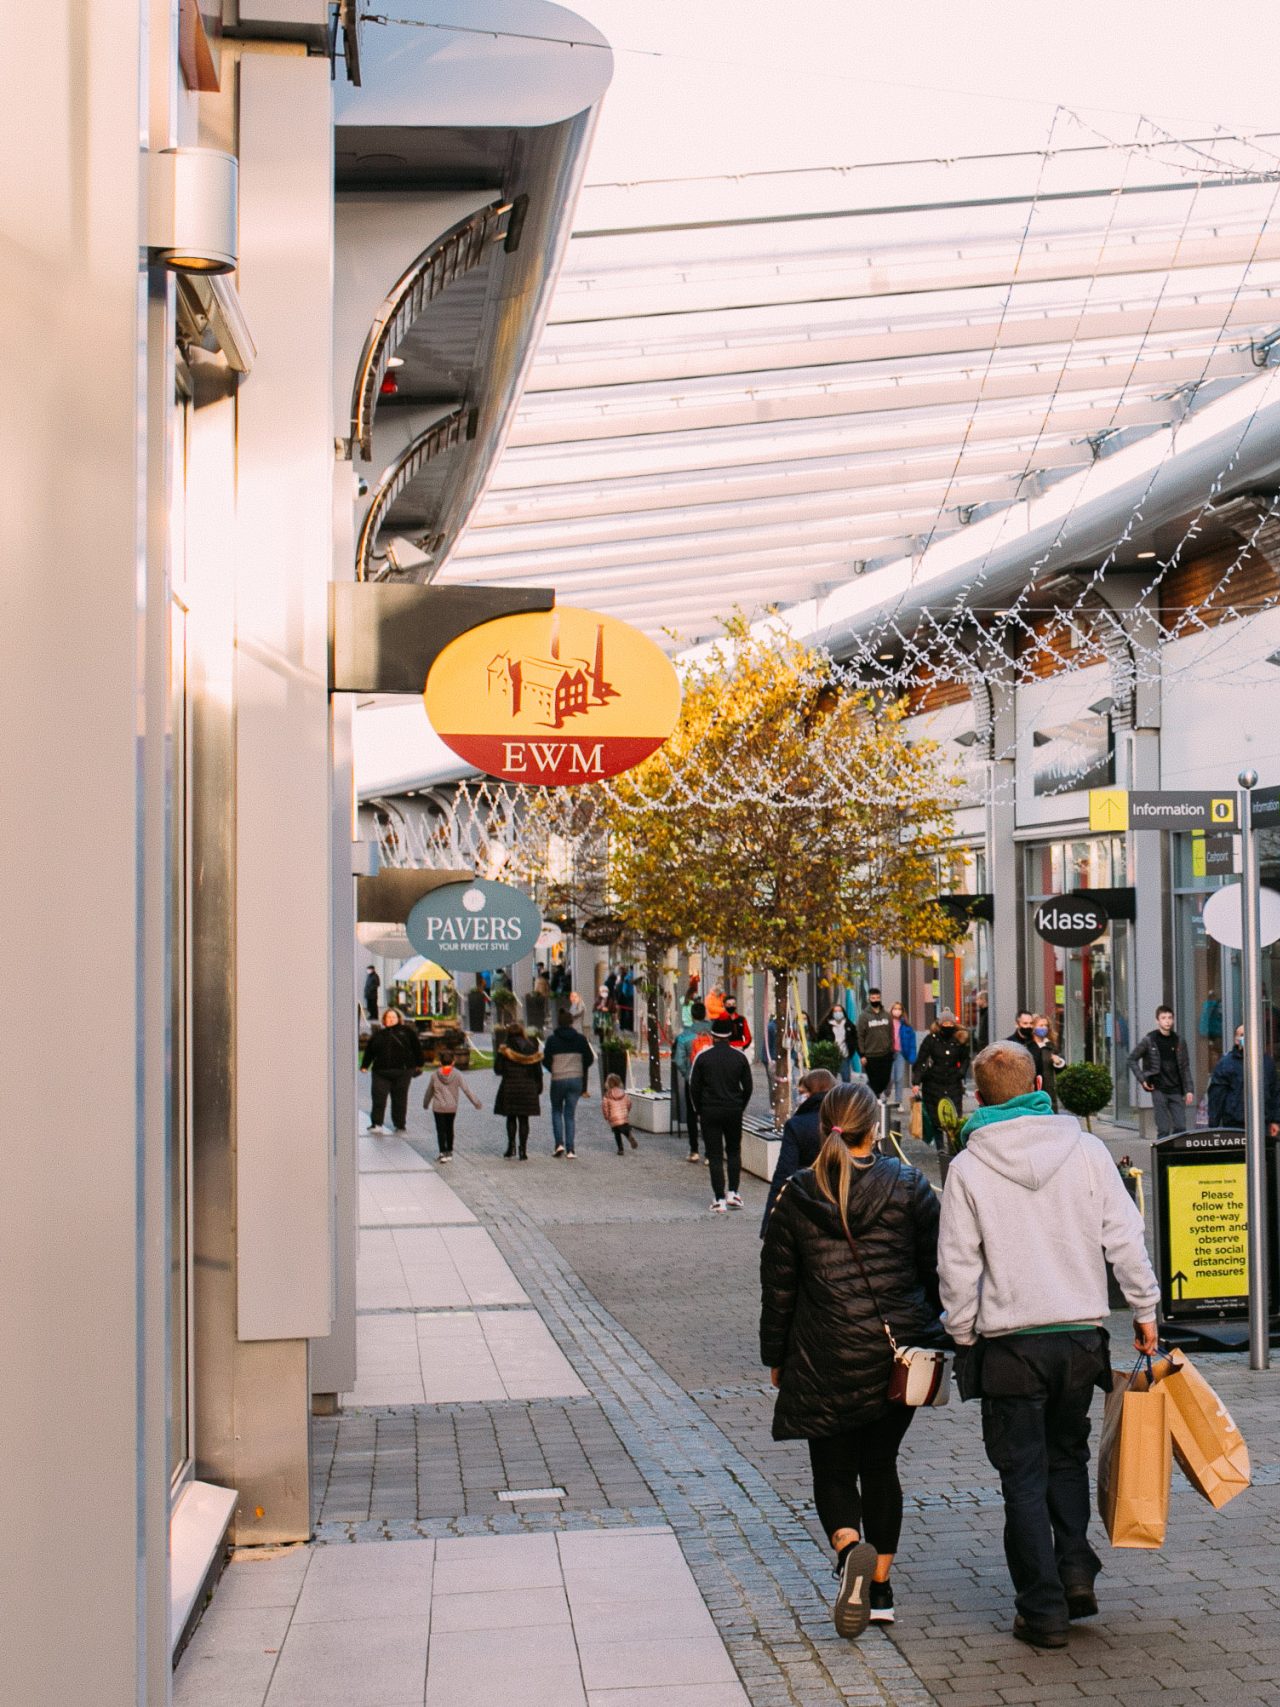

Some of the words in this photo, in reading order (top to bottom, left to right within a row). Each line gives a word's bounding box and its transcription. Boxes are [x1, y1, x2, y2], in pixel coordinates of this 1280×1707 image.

[502, 742, 605, 774] EWM
[1132, 802, 1205, 817] Information
[426, 916, 522, 941] PAVERS
[438, 943, 459, 951] YOUR
[460, 943, 489, 951] PERFECT
[490, 943, 510, 951] STYLE
[1201, 1191, 1234, 1200] Please
[1192, 1201, 1223, 1211] follow
[1227, 1200, 1244, 1210] the
[1196, 1213, 1240, 1223] one-way
[1189, 1225, 1225, 1234] system
[1229, 1221, 1248, 1231] and
[1198, 1234, 1240, 1244] observe
[1194, 1246, 1212, 1255] the
[1214, 1245, 1244, 1254] social
[1193, 1257, 1246, 1267] distancing
[1195, 1268, 1244, 1278] measures
